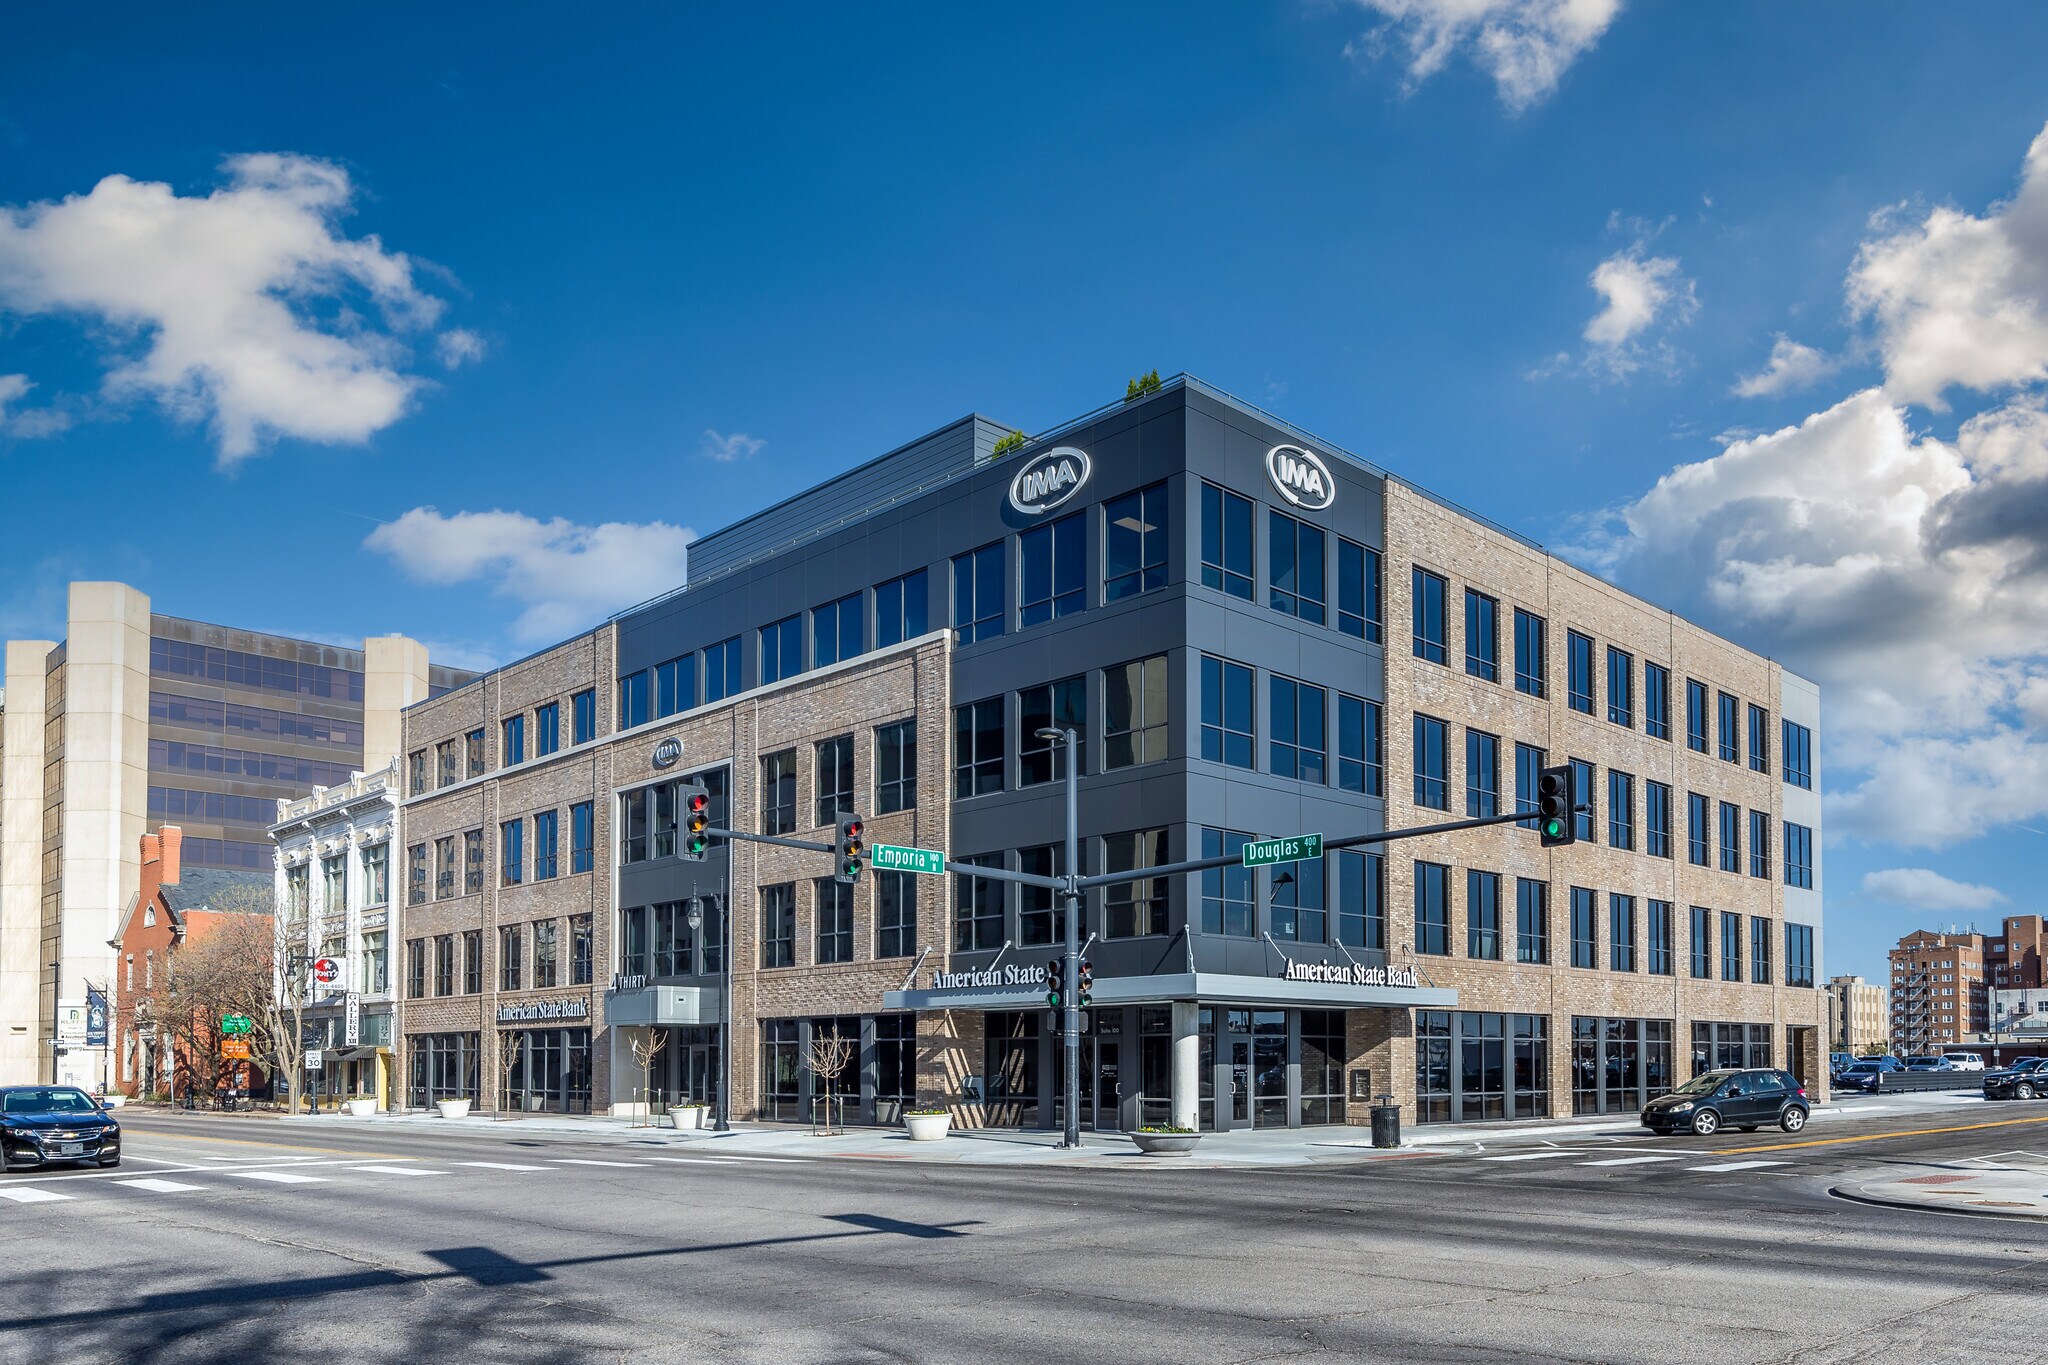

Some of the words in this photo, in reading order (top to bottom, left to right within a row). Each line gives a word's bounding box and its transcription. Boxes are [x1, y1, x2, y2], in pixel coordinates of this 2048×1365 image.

[1023, 459, 1078, 502] IMA
[1278, 455, 1326, 500] IMA
[660, 743, 680, 759] IMA
[877, 845, 925, 868] Emporia
[929, 852, 940, 863] 100
[1249, 840, 1299, 862] Douglas
[1303, 837, 1317, 847] 400
[1308, 847, 1313, 857] E
[932, 965, 1002, 989] American
[1004, 964, 1045, 985] State
[1285, 957, 1352, 983] American
[1353, 962, 1386, 985] State
[1386, 965, 1419, 987] Bank
[348, 994, 357, 1037] GALLERY
[497, 1003, 538, 1020] American
[538, 1001, 561, 1018] State
[561, 997, 587, 1017] Bank
[307, 1059, 320, 1067] 30
